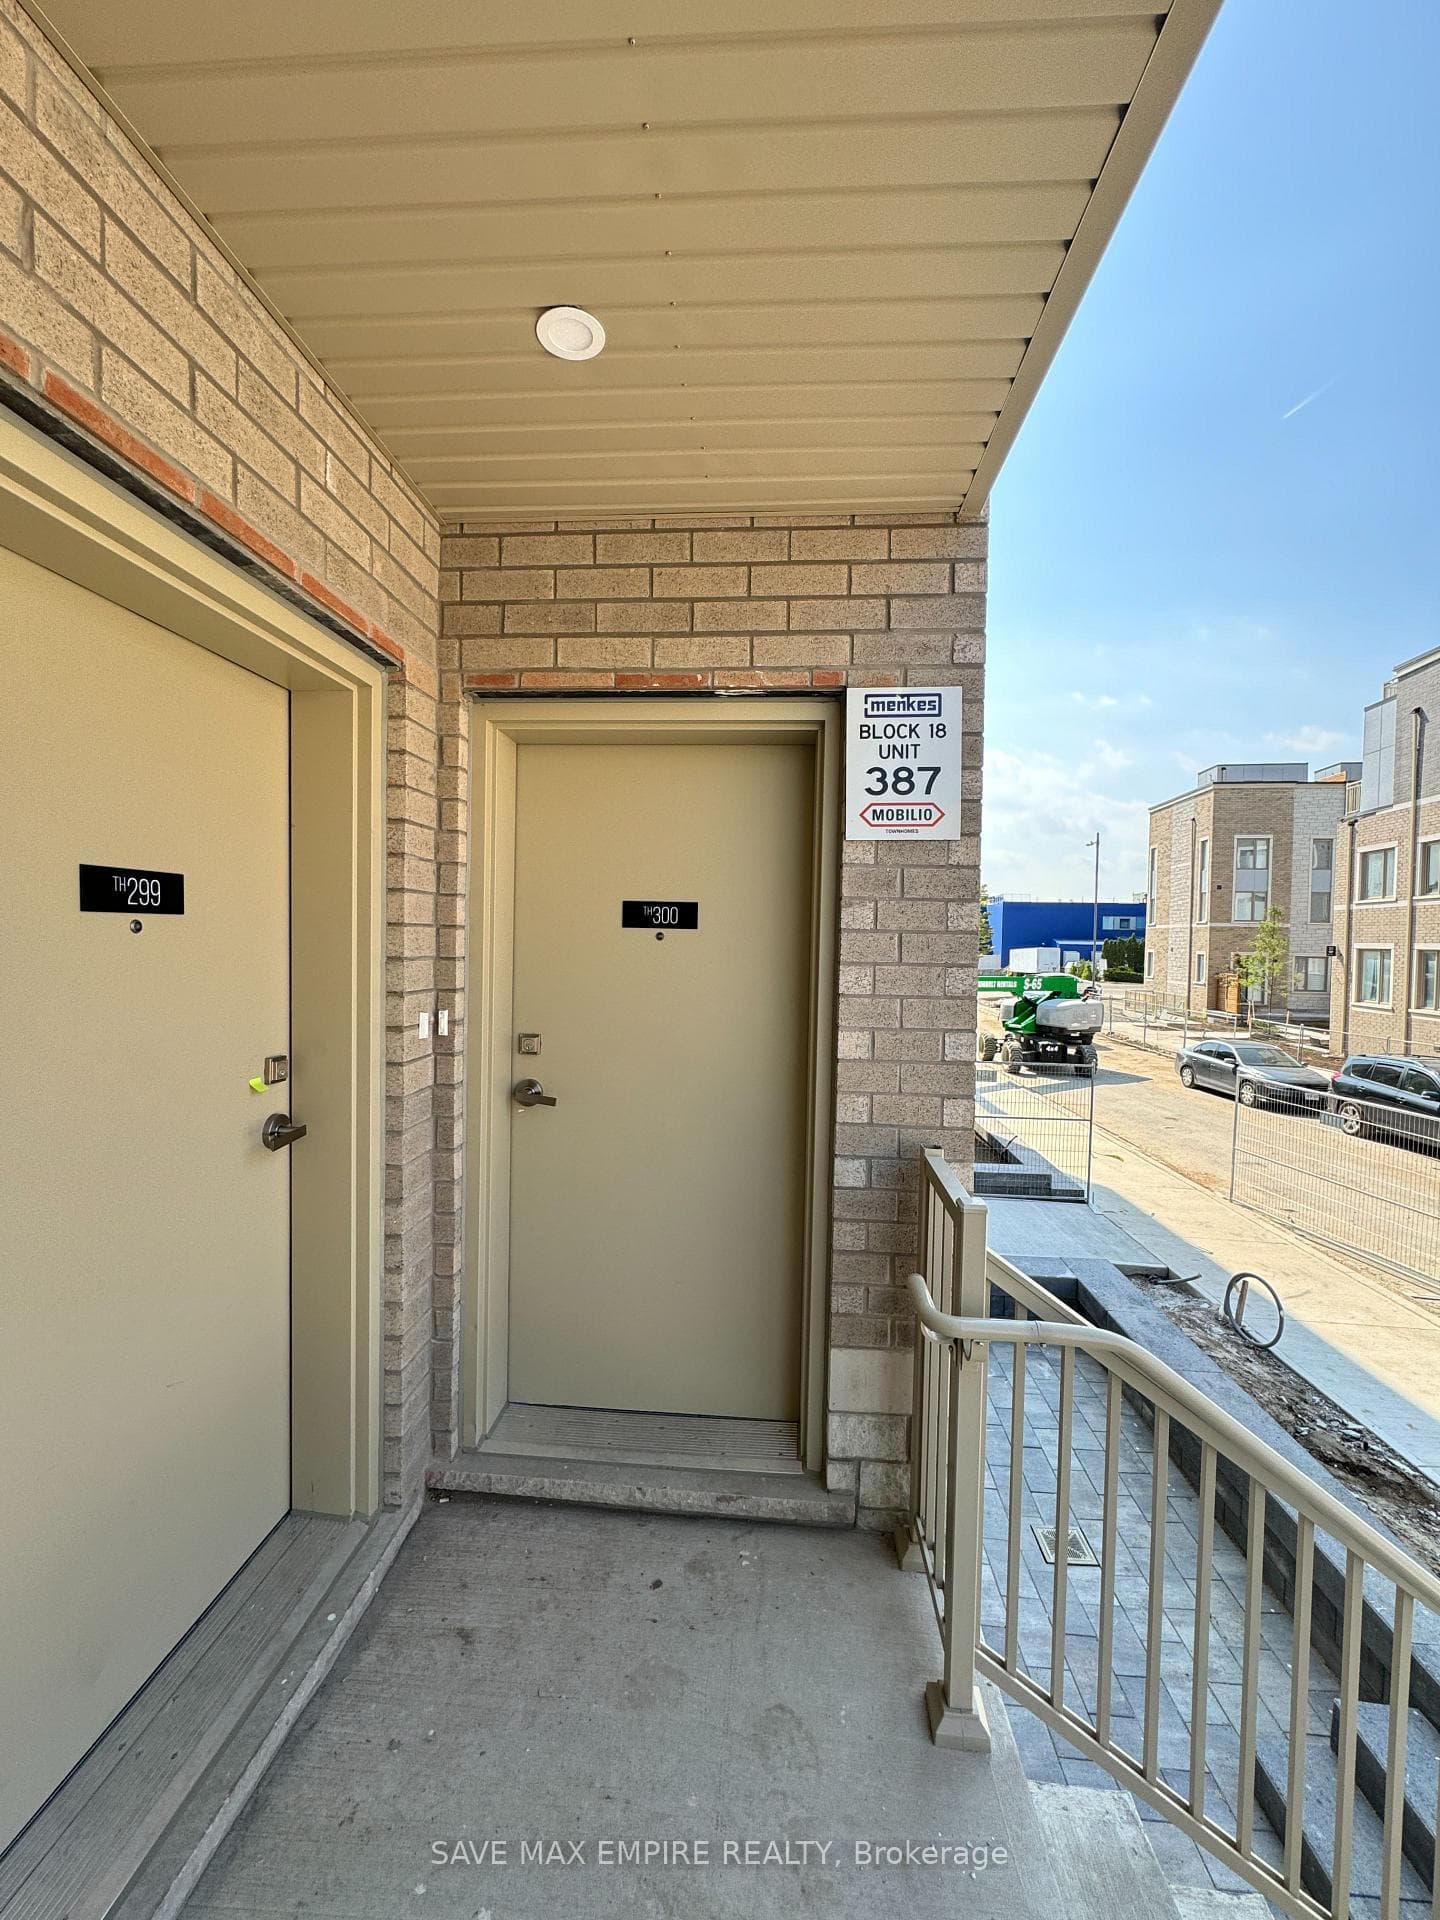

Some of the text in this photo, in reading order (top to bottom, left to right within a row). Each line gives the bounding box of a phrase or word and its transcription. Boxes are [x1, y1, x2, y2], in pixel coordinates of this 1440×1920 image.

[870, 696, 937, 712] menkes
[859, 723, 947, 739] BLOCK 18
[878, 744, 921, 760] UNIT
[864, 766, 942, 796] 387
[872, 808, 933, 821] MOBILIO
[1023, 977, 1043, 990] S-65
